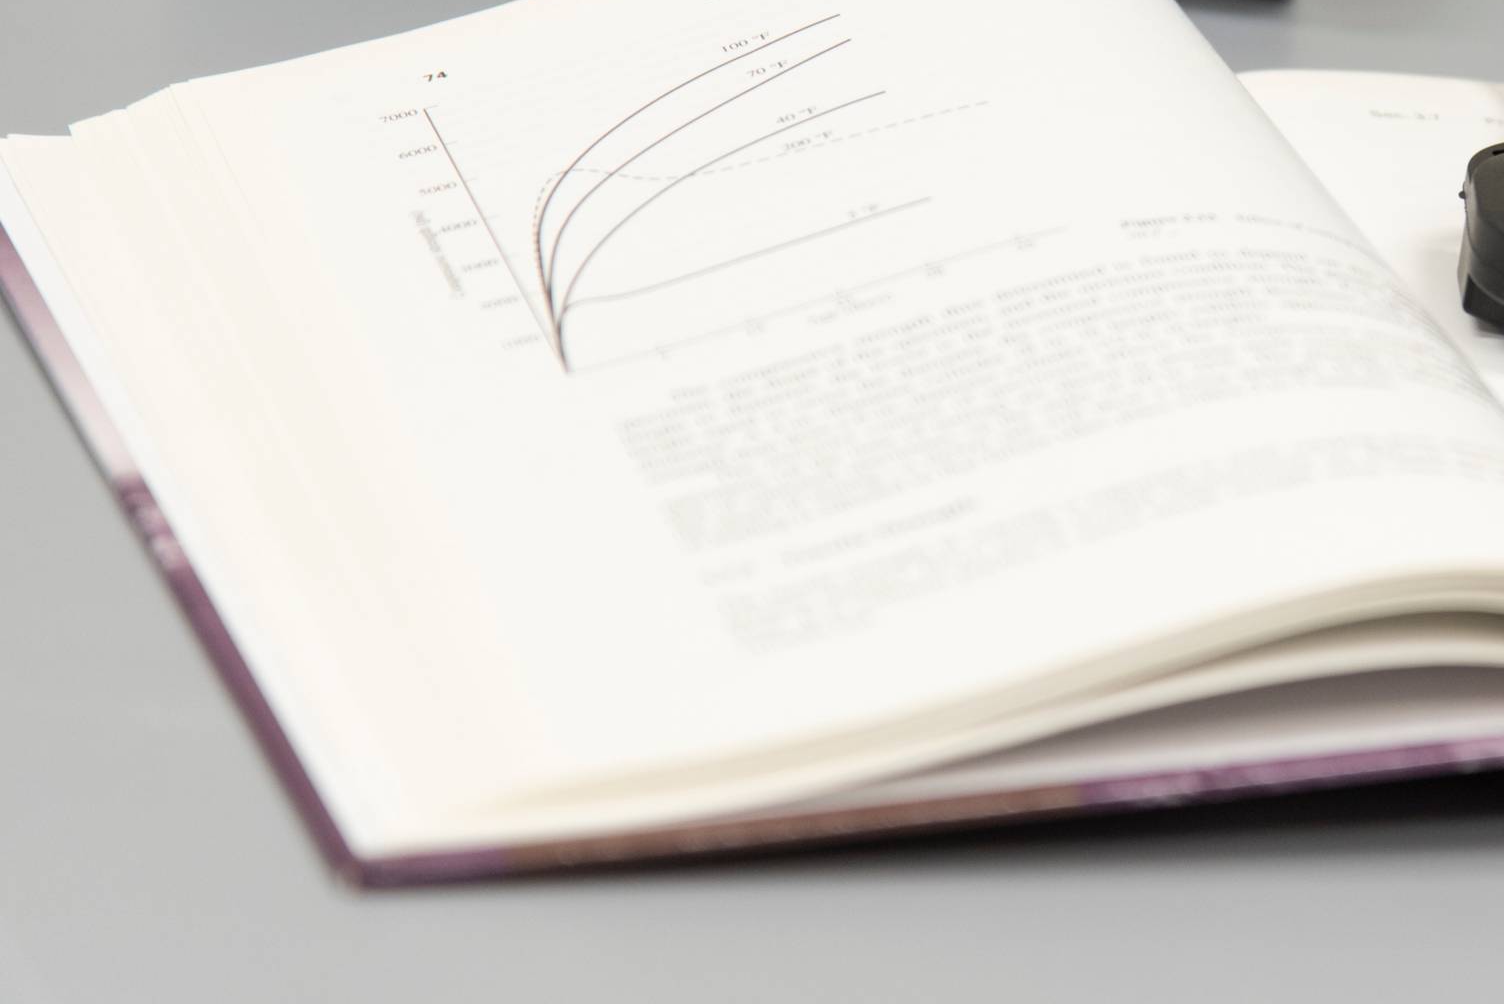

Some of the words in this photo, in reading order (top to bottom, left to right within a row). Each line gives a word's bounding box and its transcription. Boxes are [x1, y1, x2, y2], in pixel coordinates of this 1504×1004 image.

[722, 39, 749, 53] 100
[422, 70, 448, 83] 74
[746, 66, 767, 77] 70
[378, 108, 419, 123] 7000
[398, 143, 439, 159] 6000
